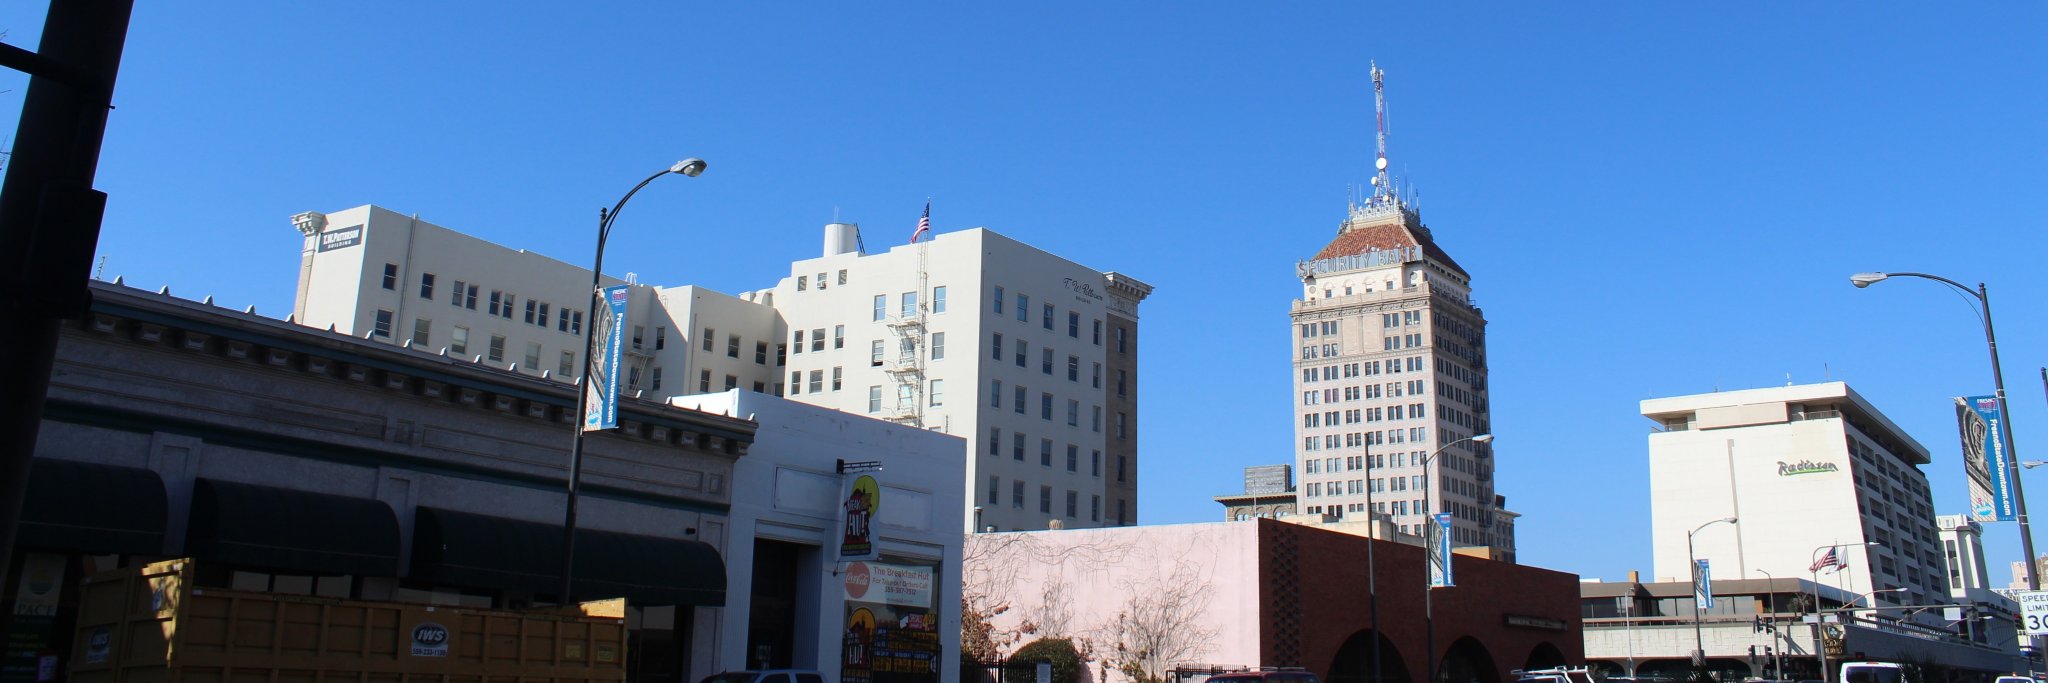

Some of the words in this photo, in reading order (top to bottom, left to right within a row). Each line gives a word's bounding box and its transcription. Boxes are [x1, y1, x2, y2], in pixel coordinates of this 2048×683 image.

[327, 239, 352, 249] BUILDING
[1298, 253, 1371, 277] SECURITY
[1377, 245, 1418, 265] BANK
[607, 312, 623, 423] FresnoStateDowntown.com
[1776, 459, 1839, 477] Radisson
[1990, 418, 2011, 516] FresnoStateDowntown.com
[873, 566, 886, 576] The
[887, 568, 917, 579] Breakfast
[917, 571, 930, 581] Hut
[417, 629, 445, 642] IWS
